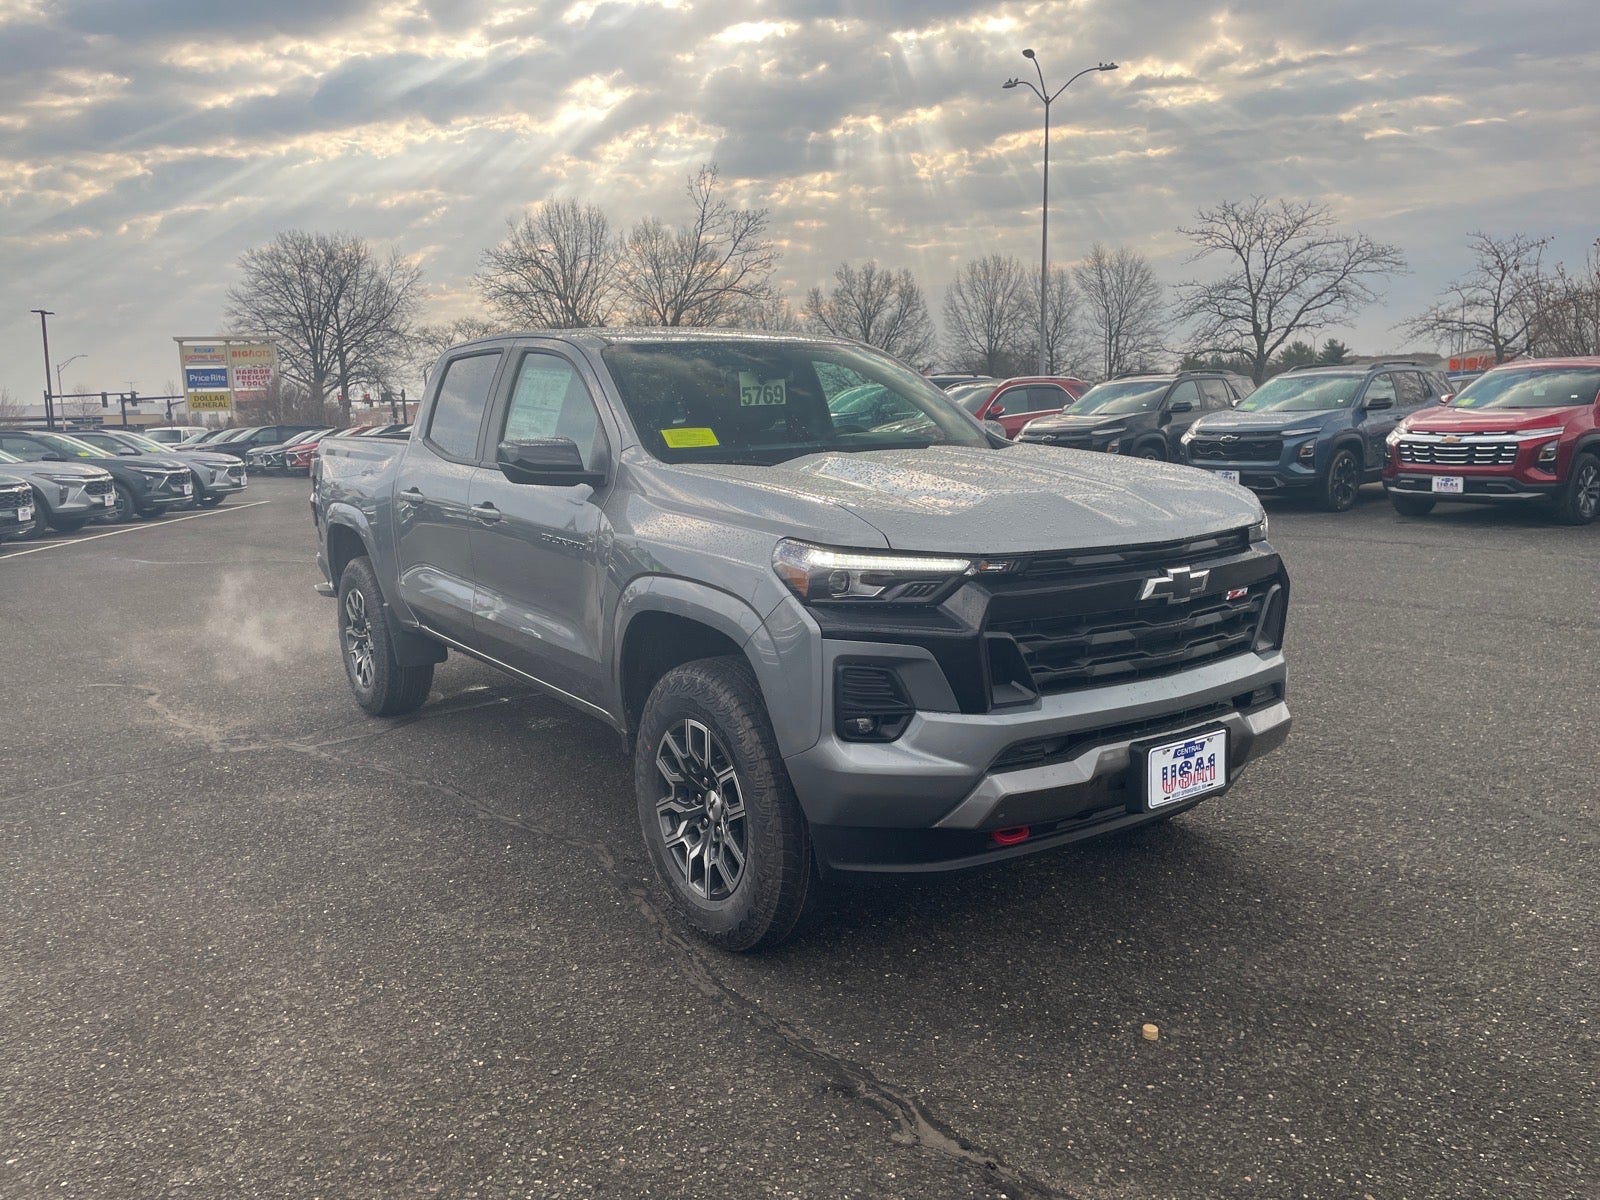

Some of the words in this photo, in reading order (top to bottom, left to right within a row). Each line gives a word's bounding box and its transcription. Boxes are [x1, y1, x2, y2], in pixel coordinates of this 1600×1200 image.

[189, 374, 210, 382] Price
[210, 374, 226, 382] Rite
[741, 385, 784, 405] 5769
[1176, 744, 1202, 757] CENTRAL
